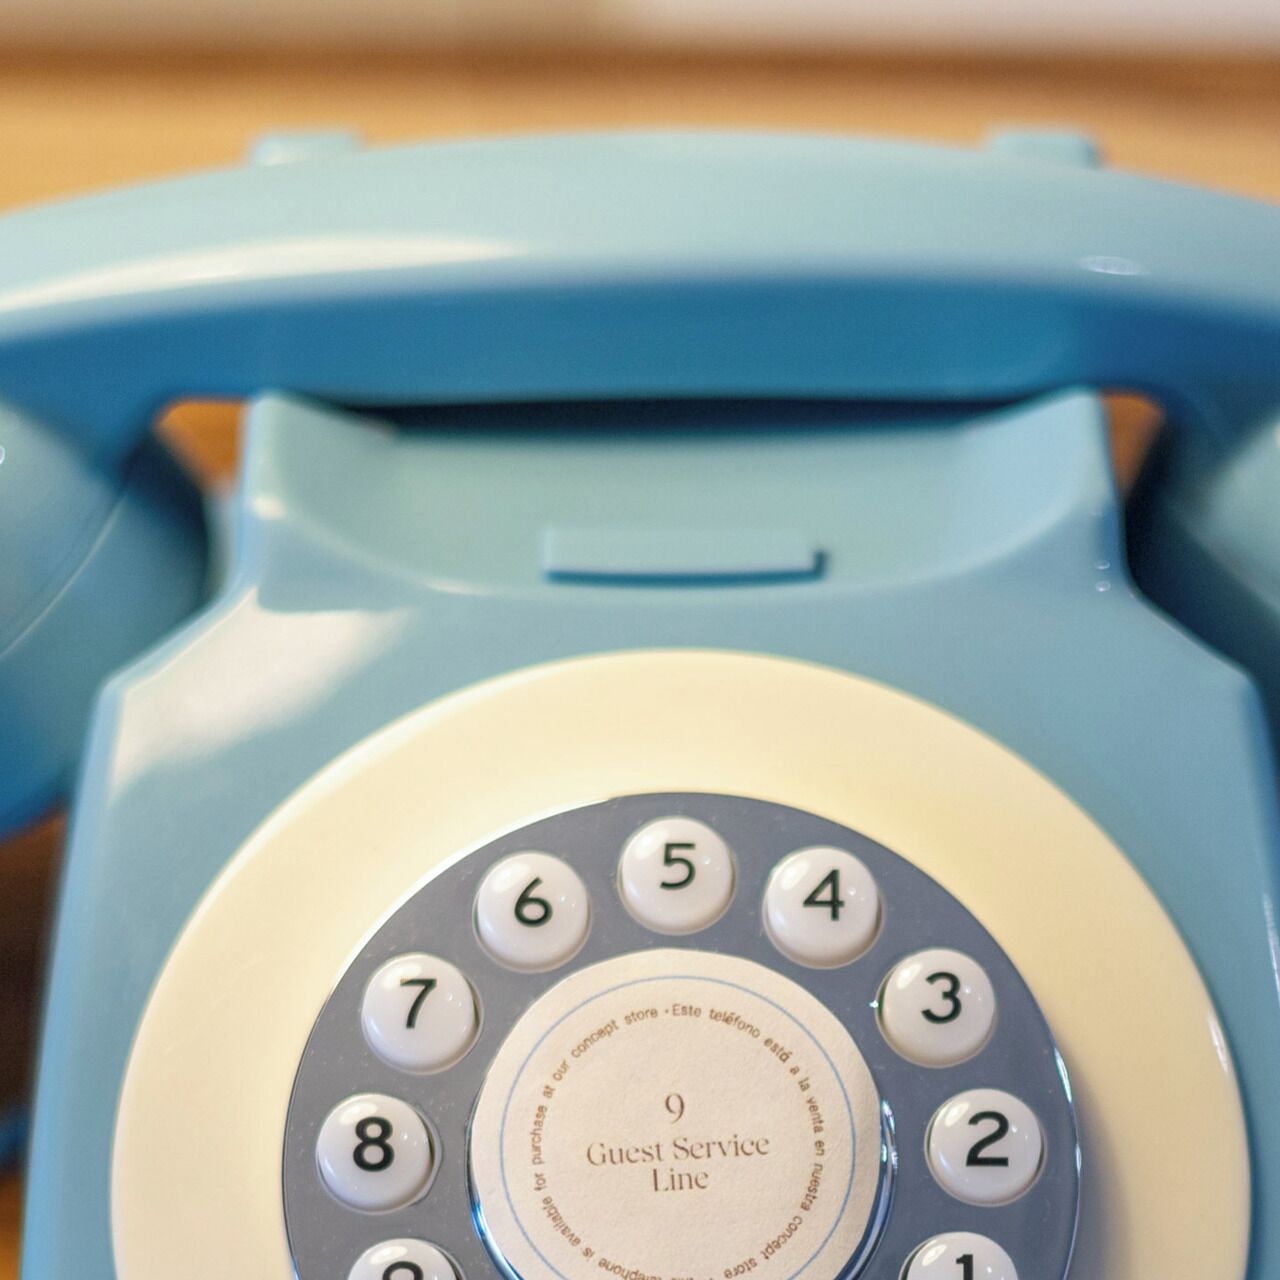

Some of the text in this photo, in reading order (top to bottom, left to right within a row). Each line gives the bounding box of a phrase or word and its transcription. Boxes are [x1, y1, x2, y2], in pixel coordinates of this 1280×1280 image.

[659, 842, 696, 891] 5
[513, 877, 553, 927] 6
[802, 869, 845, 921] 4
[399, 978, 437, 1030] 7
[623, 1007, 658, 1025] store
[920, 971, 962, 1025] 3
[571, 1019, 619, 1058] concept
[542, 1085, 556, 1099] at
[552, 1059, 570, 1081] our
[664, 1092, 686, 1125] 9
[352, 1116, 395, 1173] 8
[530, 1105, 548, 1165] purchase
[586, 1133, 770, 1167] Guest Service
[672, 1003, 825, 1279] Este teléfono está a la venta en nuestra concept store
[965, 1110, 1010, 1168] 2
[534, 1172, 547, 1191] for
[652, 1167, 709, 1193] Line
[542, 1196, 581, 1247] available
[582, 1247, 595, 1262] is
